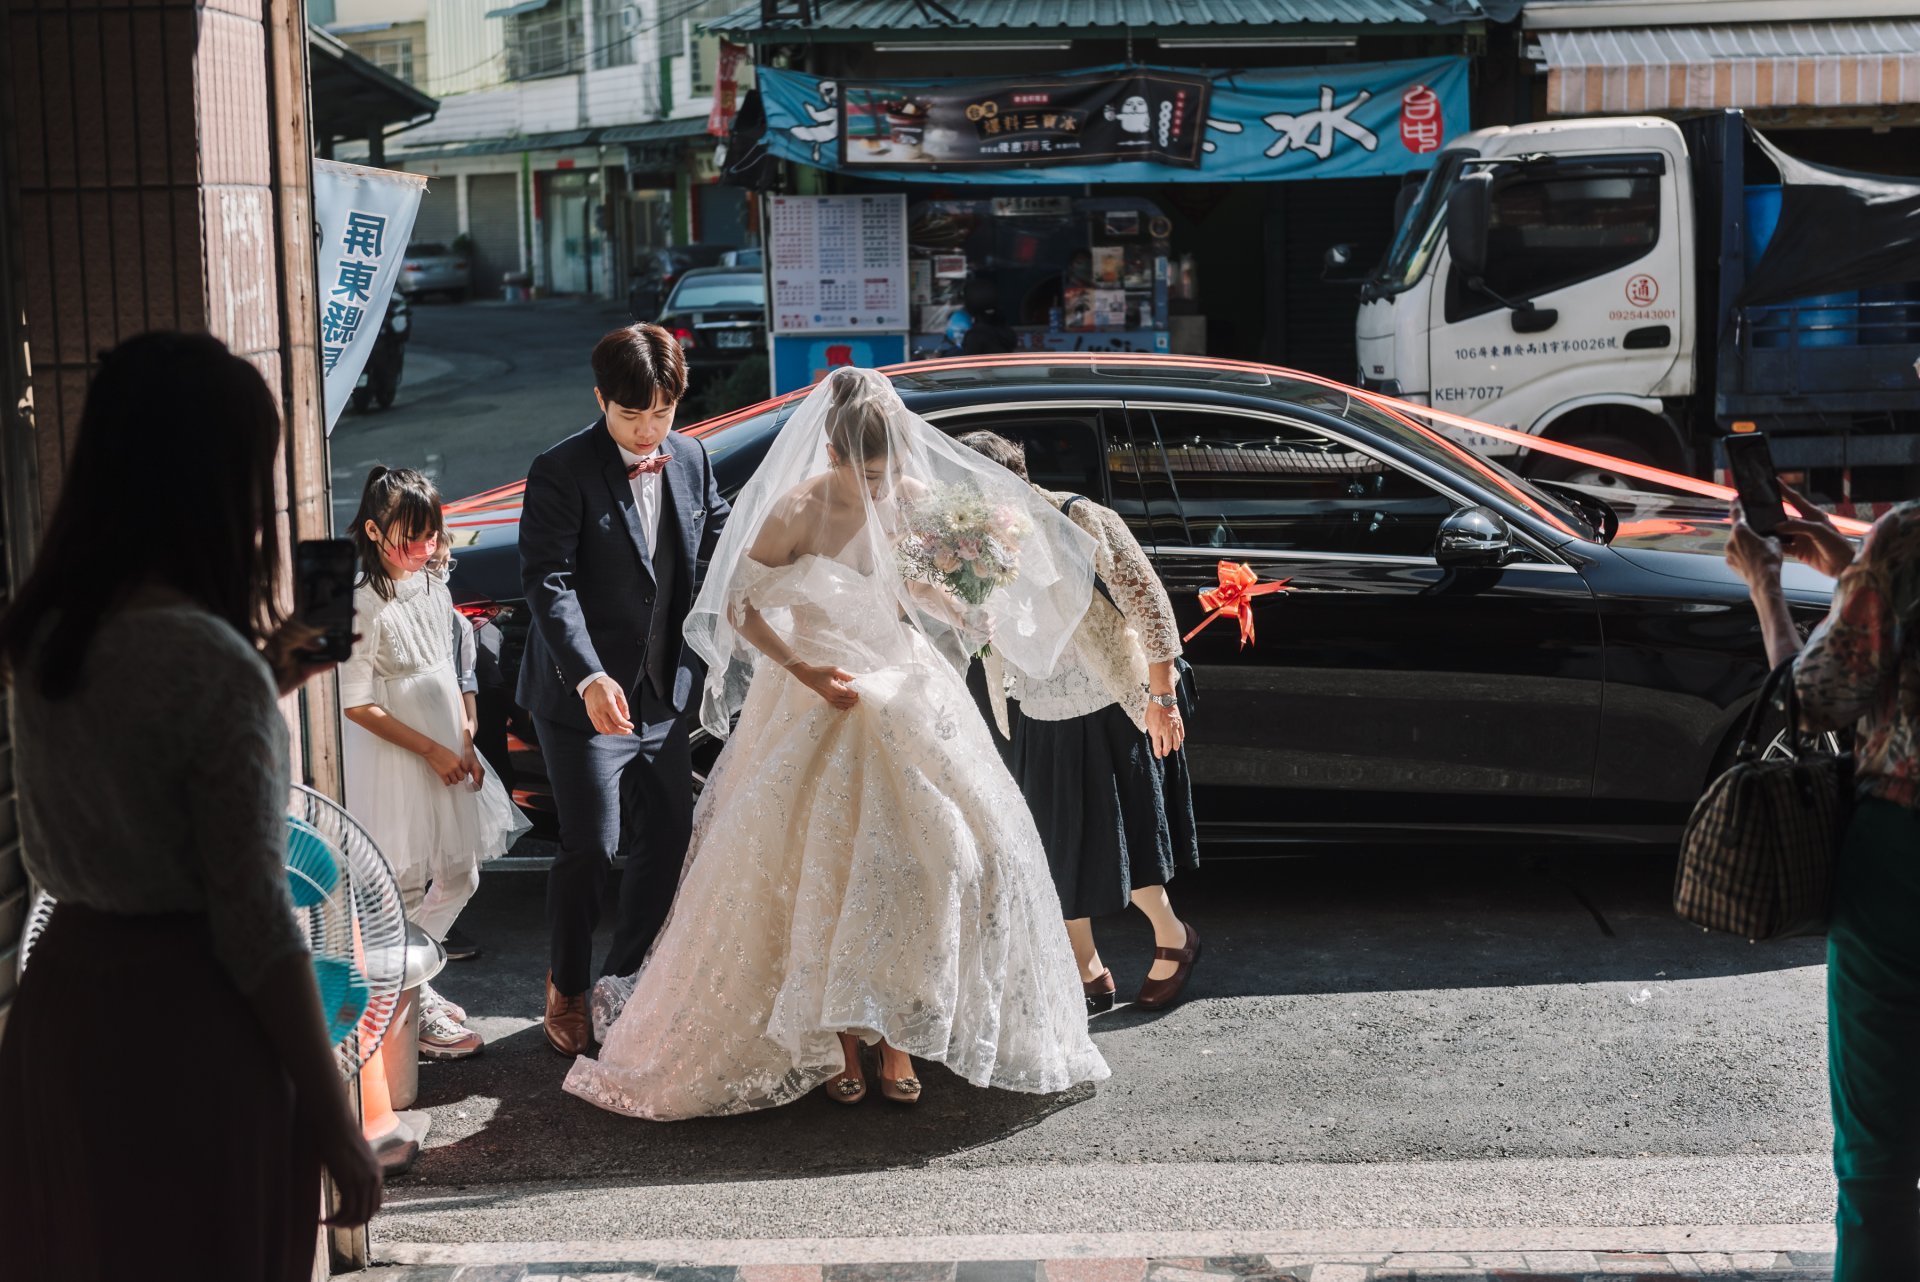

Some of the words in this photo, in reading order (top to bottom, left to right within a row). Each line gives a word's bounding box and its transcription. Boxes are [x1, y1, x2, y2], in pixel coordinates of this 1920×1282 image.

[1403, 85, 1438, 154] 台中
[1632, 279, 1651, 302] 通
[1609, 309, 1676, 321] 0925443001
